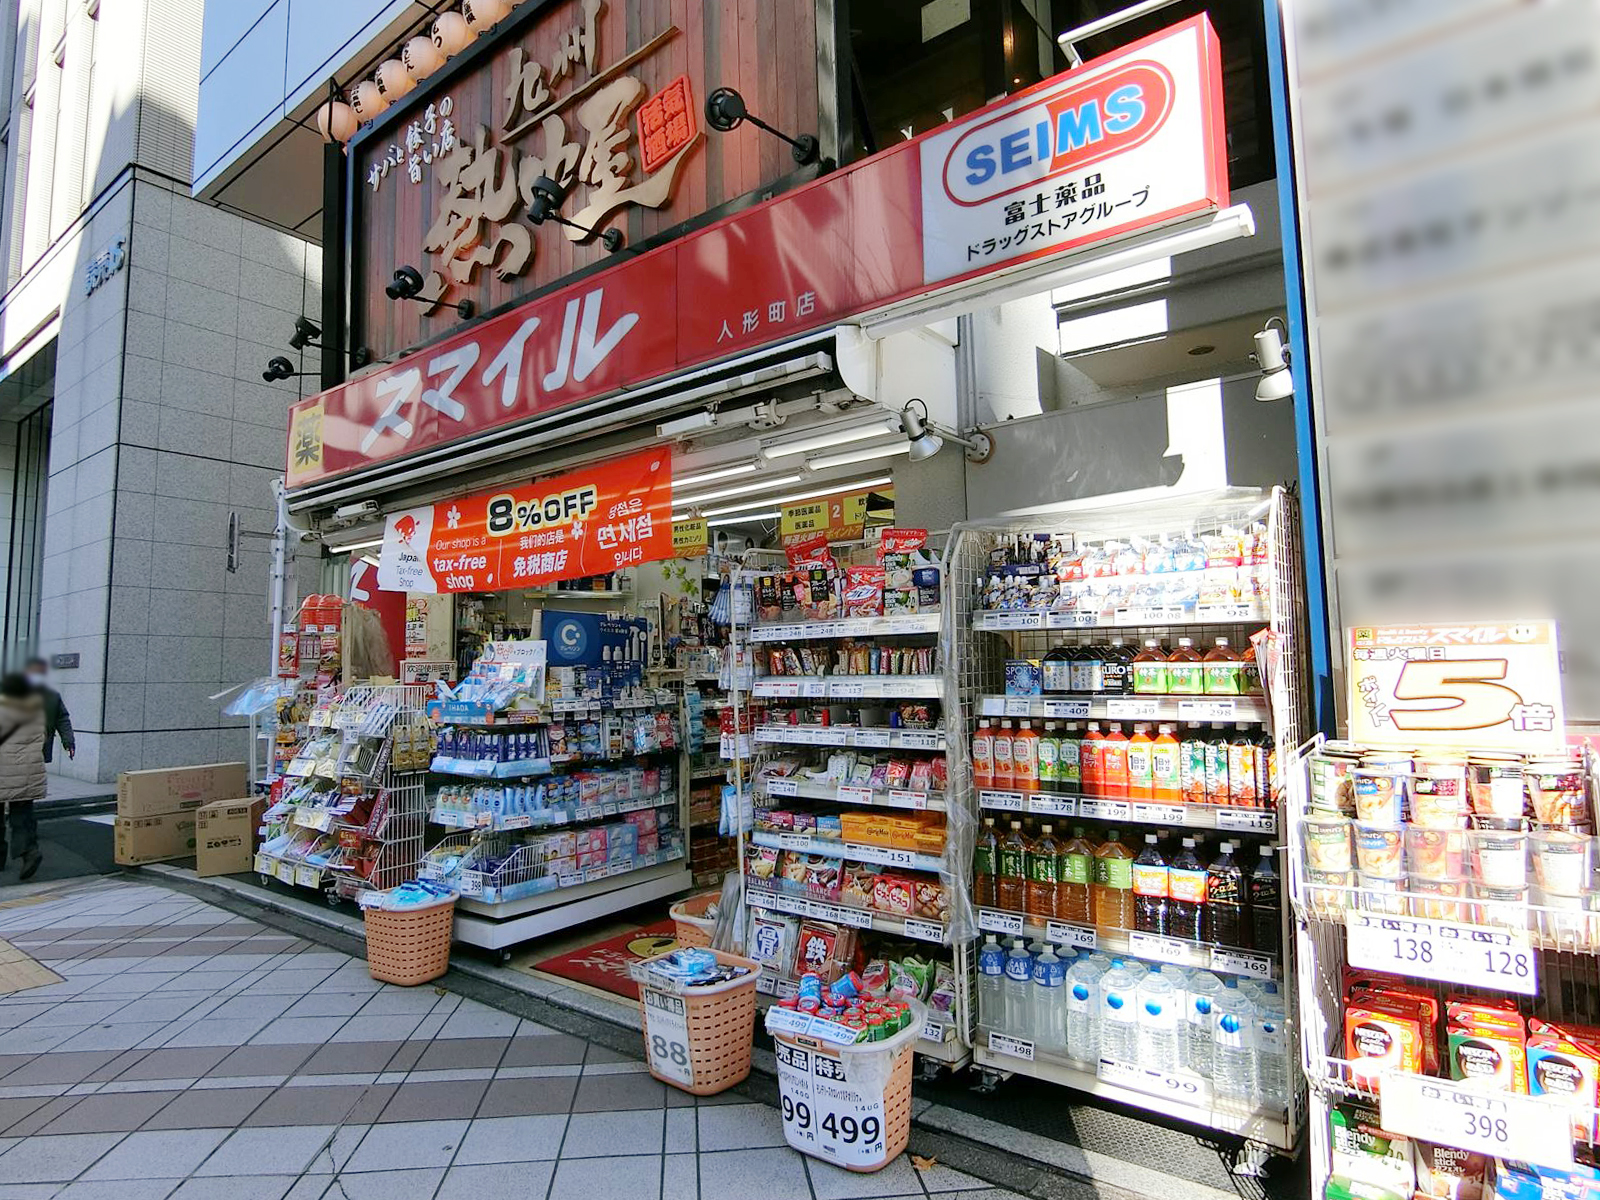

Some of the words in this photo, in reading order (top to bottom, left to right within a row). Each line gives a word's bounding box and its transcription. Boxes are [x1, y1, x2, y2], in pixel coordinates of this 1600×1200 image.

[503, 0, 599, 131] 九州
[965, 83, 1146, 186] SEIMS
[1004, 172, 1106, 226] 富士薬品
[967, 185, 1151, 262] ドラッグストアグループ
[717, 291, 816, 343] 人形町店
[361, 287, 640, 454] スマイル
[490, 490, 594, 533] 8%OFF
[608, 498, 643, 520] 당점은
[832, 505, 841, 518] 2
[519, 529, 565, 550] 我们的店是
[597, 512, 653, 551] 면세점
[435, 539, 450, 551] Our
[452, 537, 470, 550] shop
[472, 537, 481, 547] is
[433, 554, 487, 572] tax-free
[513, 550, 568, 577] 免税商店
[613, 547, 643, 568] 입니다
[396, 565, 423, 576] Tax-free
[399, 577, 414, 588] Shop
[445, 573, 475, 590] shop
[1021, 617, 1039, 625] 100
[1227, 609, 1249, 618] 98
[1427, 626, 1506, 644] スマイル
[1353, 646, 1446, 661] 毎週火曜日
[1005, 666, 1039, 675] SPORTS
[1389, 658, 1523, 731] 5
[1069, 706, 1089, 715] 409
[1508, 702, 1556, 731] 倍
[1003, 799, 1021, 807] 178
[1054, 804, 1072, 812] 178
[1107, 808, 1126, 816] 199
[1163, 813, 1183, 821] 199
[1250, 820, 1273, 829] 119
[890, 853, 911, 863] 151
[891, 892, 908, 908] ビスコ
[825, 911, 839, 919] 168
[856, 916, 870, 924] 168
[1003, 921, 1021, 930] 169
[925, 929, 941, 939] 98
[1074, 934, 1094, 943] 169
[1160, 947, 1181, 956] 169
[1393, 937, 1434, 963] 138
[1243, 961, 1267, 972] 169
[1485, 950, 1529, 977] 128
[788, 1019, 807, 1029] 499
[923, 1028, 940, 1037] 132
[652, 1034, 688, 1066] 88
[777, 1044, 808, 1071] 売品
[1013, 1045, 1032, 1056] 198
[1165, 1077, 1198, 1093] 99
[821, 1111, 880, 1145] 499
[1464, 1112, 1509, 1142] 398
[1334, 1125, 1376, 1146] Blendy
[1434, 1147, 1470, 1163] Blendy
[1434, 1157, 1457, 1167] stick
